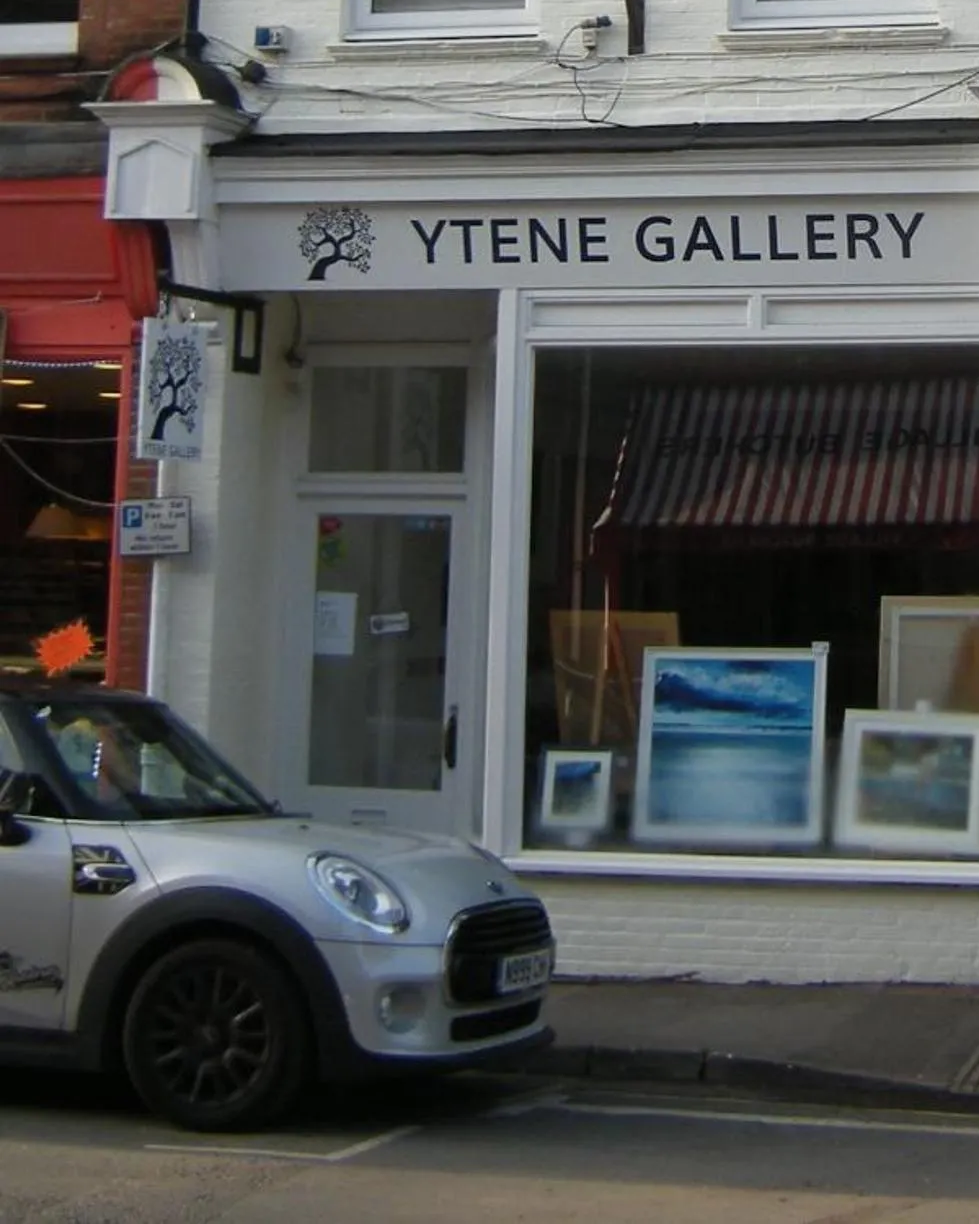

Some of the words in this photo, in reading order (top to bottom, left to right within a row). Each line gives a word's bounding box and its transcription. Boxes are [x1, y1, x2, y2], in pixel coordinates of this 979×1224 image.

[411, 217, 609, 264] YTENE
[634, 212, 926, 263] GALLERY
[127, 508, 140, 526] P
